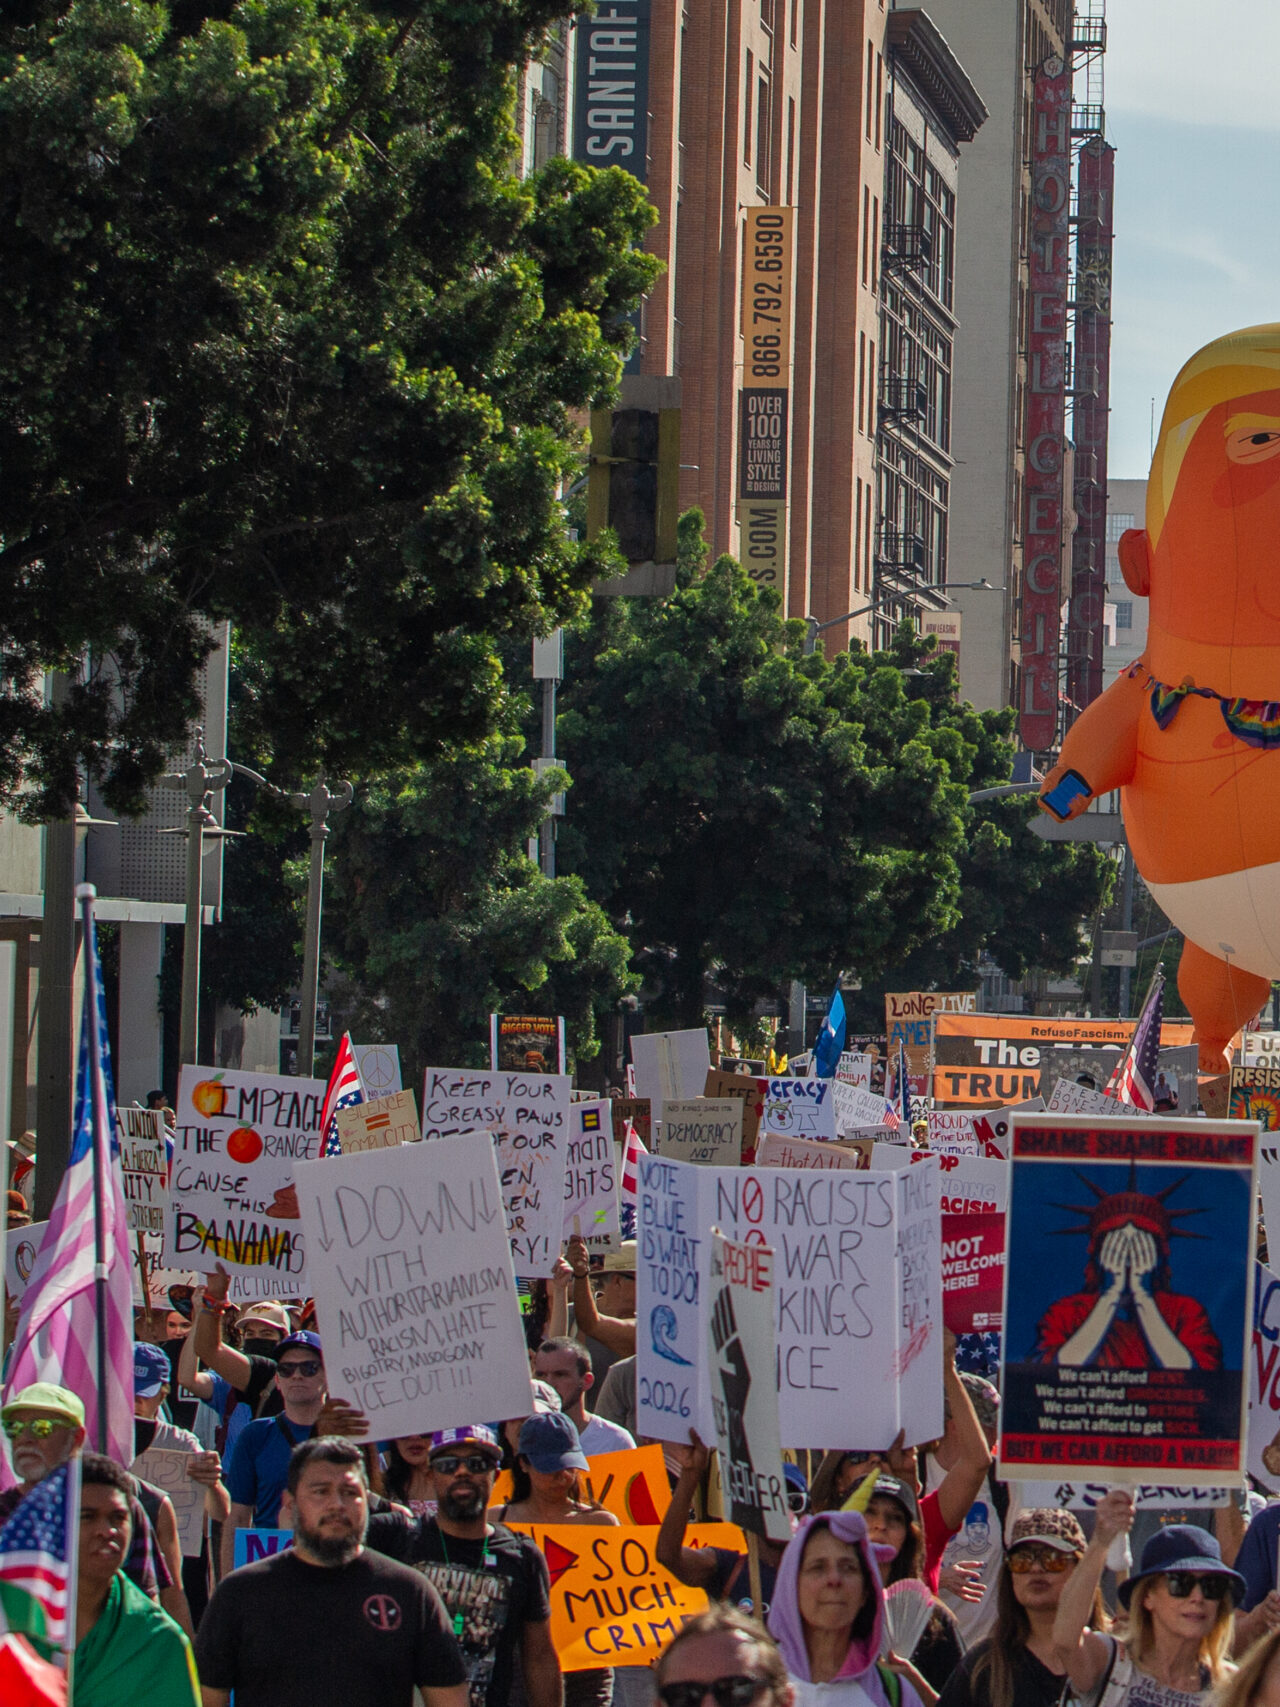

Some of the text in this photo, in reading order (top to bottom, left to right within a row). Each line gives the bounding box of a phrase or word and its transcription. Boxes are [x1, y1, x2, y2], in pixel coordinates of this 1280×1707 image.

[1029, 111, 1067, 394] HOTEL
[752, 214, 785, 378] 866.792.6590
[748, 396, 783, 414] OVER
[747, 415, 782, 439] 100
[747, 440, 782, 450] YEARS OF
[747, 450, 782, 464] LIVING
[747, 464, 781, 481] STYLE
[753, 481, 781, 492] DESIGN
[1023, 432, 1058, 717] CECIL
[891, 994, 936, 1017] LONG
[501, 1023, 556, 1036] BIGGER VOTE
[974, 1039, 1041, 1067] The
[430, 1074, 556, 1101] KEEP YOUR
[945, 1072, 1042, 1100] TRUM
[211, 1085, 323, 1132] IMPEACH
[345, 1092, 407, 1122] SILENCE
[426, 1101, 563, 1127] GREASY PAWS
[928, 1112, 969, 1129] PROUD
[175, 1125, 225, 1154] THE
[512, 1132, 557, 1150] OUR
[667, 1121, 738, 1144] DEMOCRACY
[1019, 1130, 1089, 1156] SHAME
[1095, 1131, 1169, 1158] SHAME
[1174, 1135, 1249, 1160] SHAME
[690, 1147, 719, 1159] NOT
[638, 1160, 680, 1197] VOTE
[224, 1198, 266, 1214] THIS
[335, 1181, 477, 1249] DOWN
[643, 1193, 687, 1236] BLUE
[773, 1177, 894, 1229] RACISTS
[174, 1211, 305, 1274] BANANAS
[642, 1228, 657, 1261] IS
[658, 1235, 701, 1274] WHAT
[781, 1229, 867, 1282] WAR
[942, 1235, 984, 1261] NOT
[336, 1245, 427, 1297] WITH
[722, 1240, 771, 1294] PEOPLE
[940, 1252, 1008, 1277] WELCOME
[648, 1263, 671, 1298] TO
[940, 1273, 980, 1292] HERE!
[442, 1302, 497, 1344] HATE
[778, 1282, 873, 1339] KINGS
[775, 1342, 839, 1393] ICE
[1058, 1368, 1148, 1385] We can't afford
[352, 1380, 401, 1412] ICE
[640, 1376, 691, 1418] 2026
[1035, 1384, 1125, 1400] We can't afford
[1043, 1400, 1147, 1416] We can't afford to
[1038, 1416, 1163, 1435] We can't afford to get
[1005, 1440, 1178, 1463] BUT WE CAN AFFORD A
[591, 1537, 656, 1582] SO.
[563, 1581, 686, 1623] MUCH.
